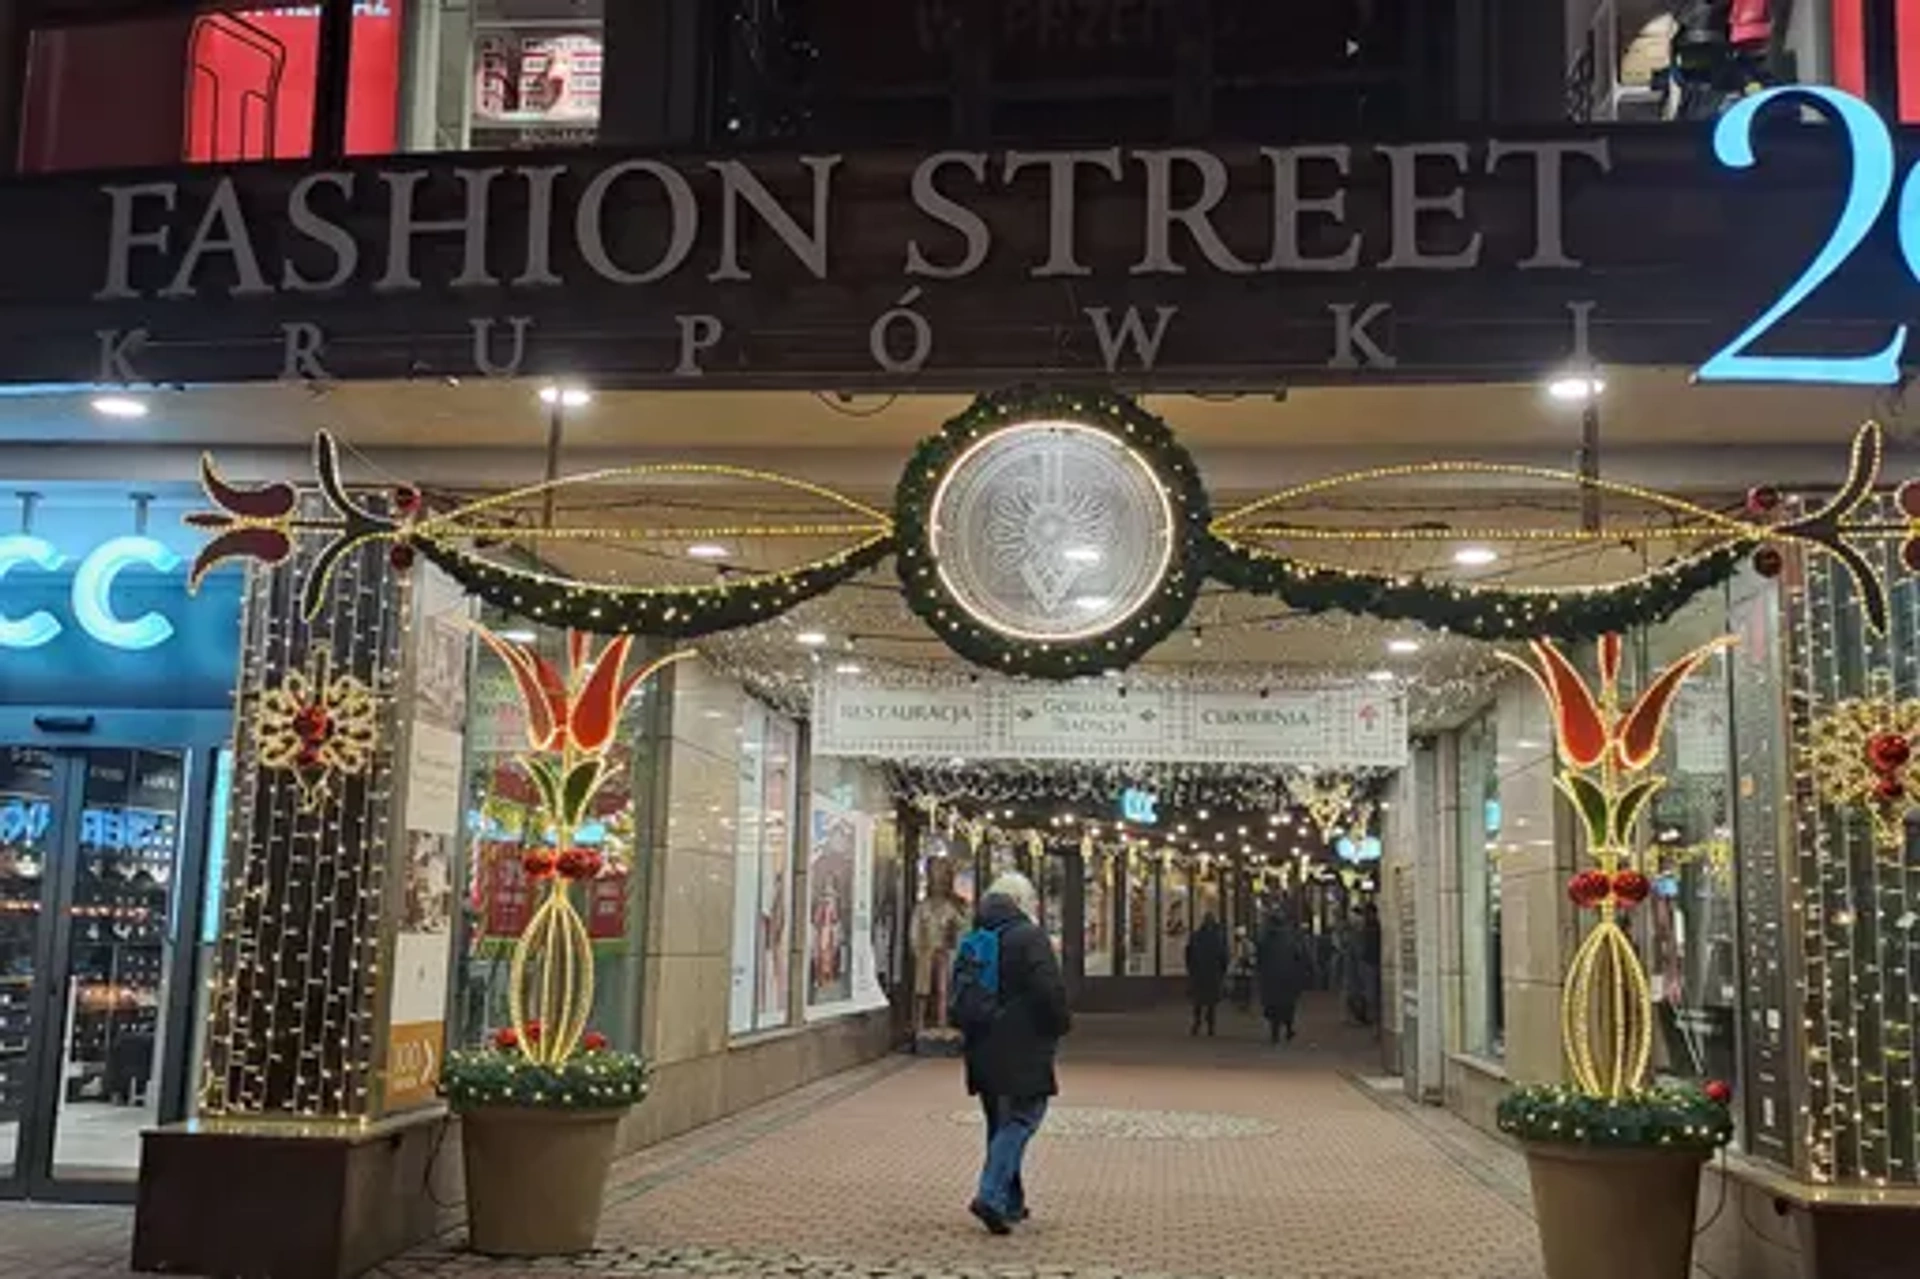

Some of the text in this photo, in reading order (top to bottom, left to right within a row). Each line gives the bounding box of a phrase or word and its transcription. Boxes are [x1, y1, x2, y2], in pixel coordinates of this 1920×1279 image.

[93, 138, 1612, 300] FASHION STREET
[1699, 86, 1920, 384] 2
